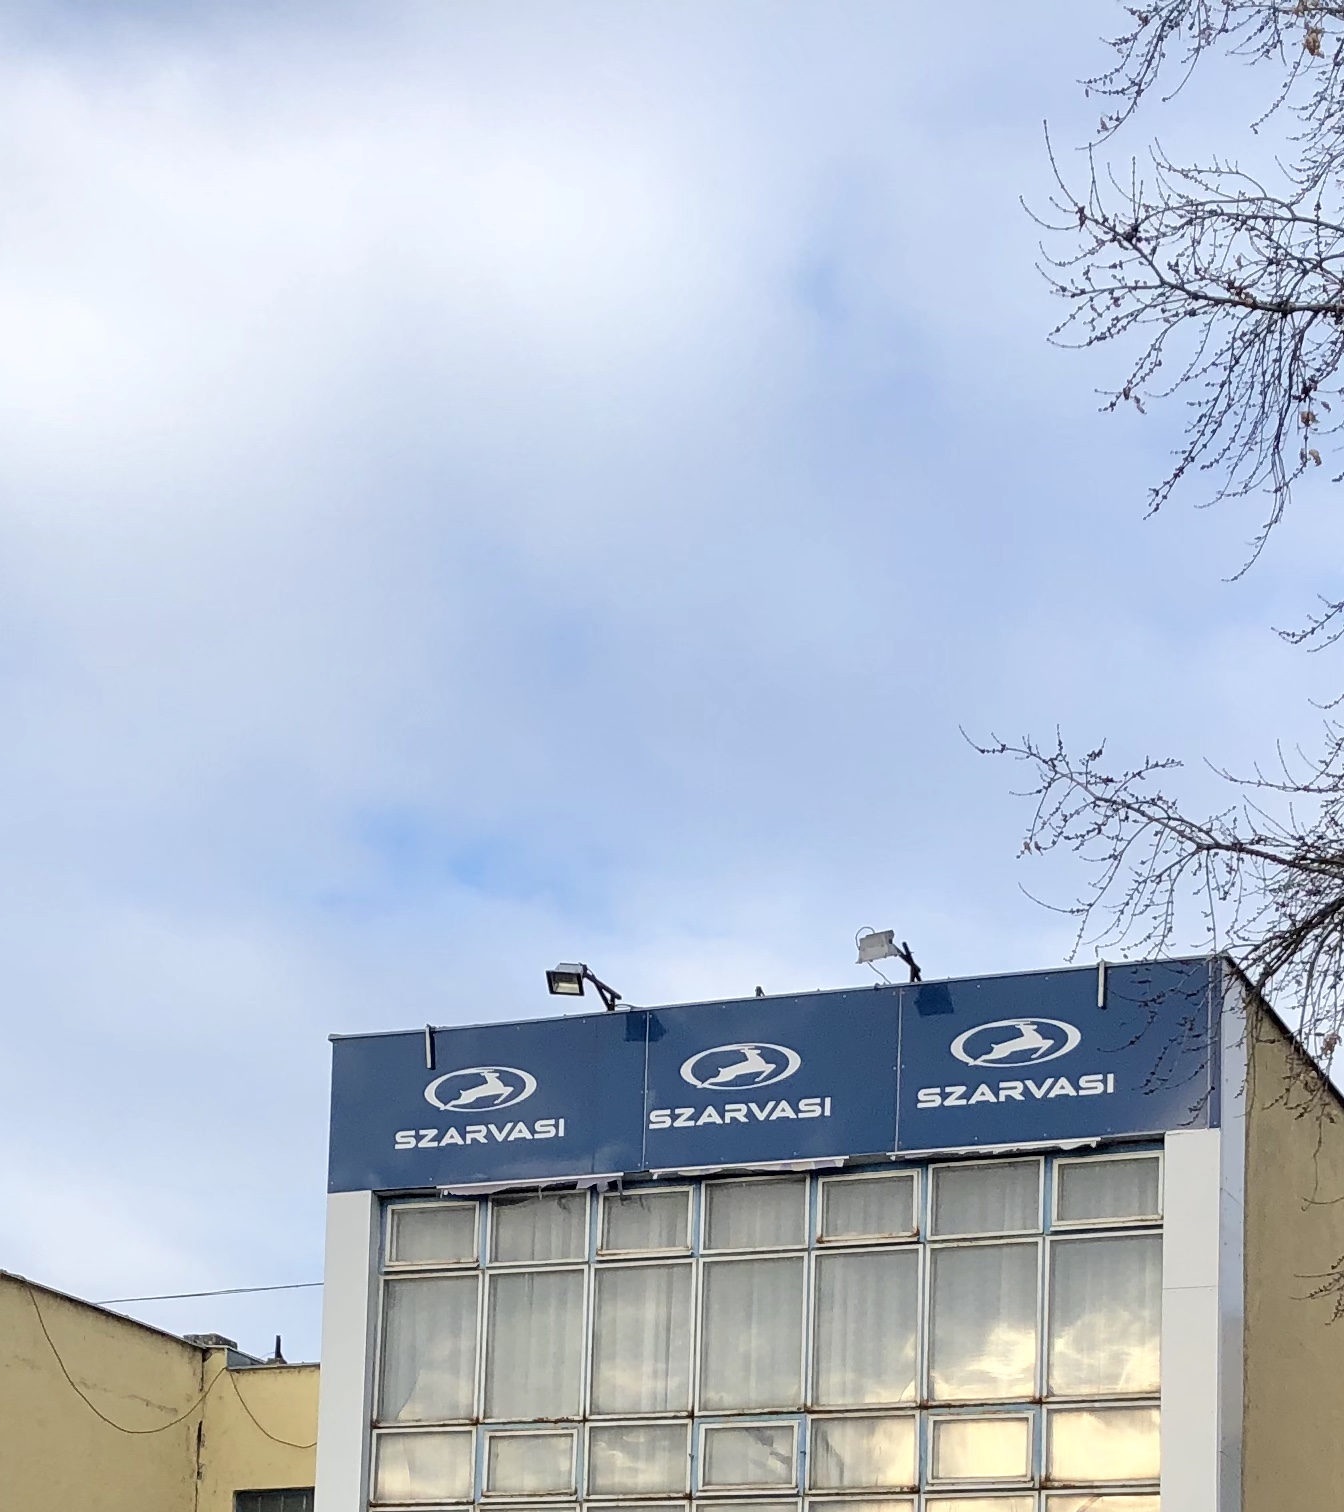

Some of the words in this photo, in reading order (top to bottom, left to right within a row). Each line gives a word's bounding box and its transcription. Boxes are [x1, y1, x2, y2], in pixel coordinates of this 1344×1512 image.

[917, 1073, 1115, 1109] SZARVASI
[648, 1097, 832, 1130] SZARVASI
[394, 1118, 565, 1150] SZARVASI
